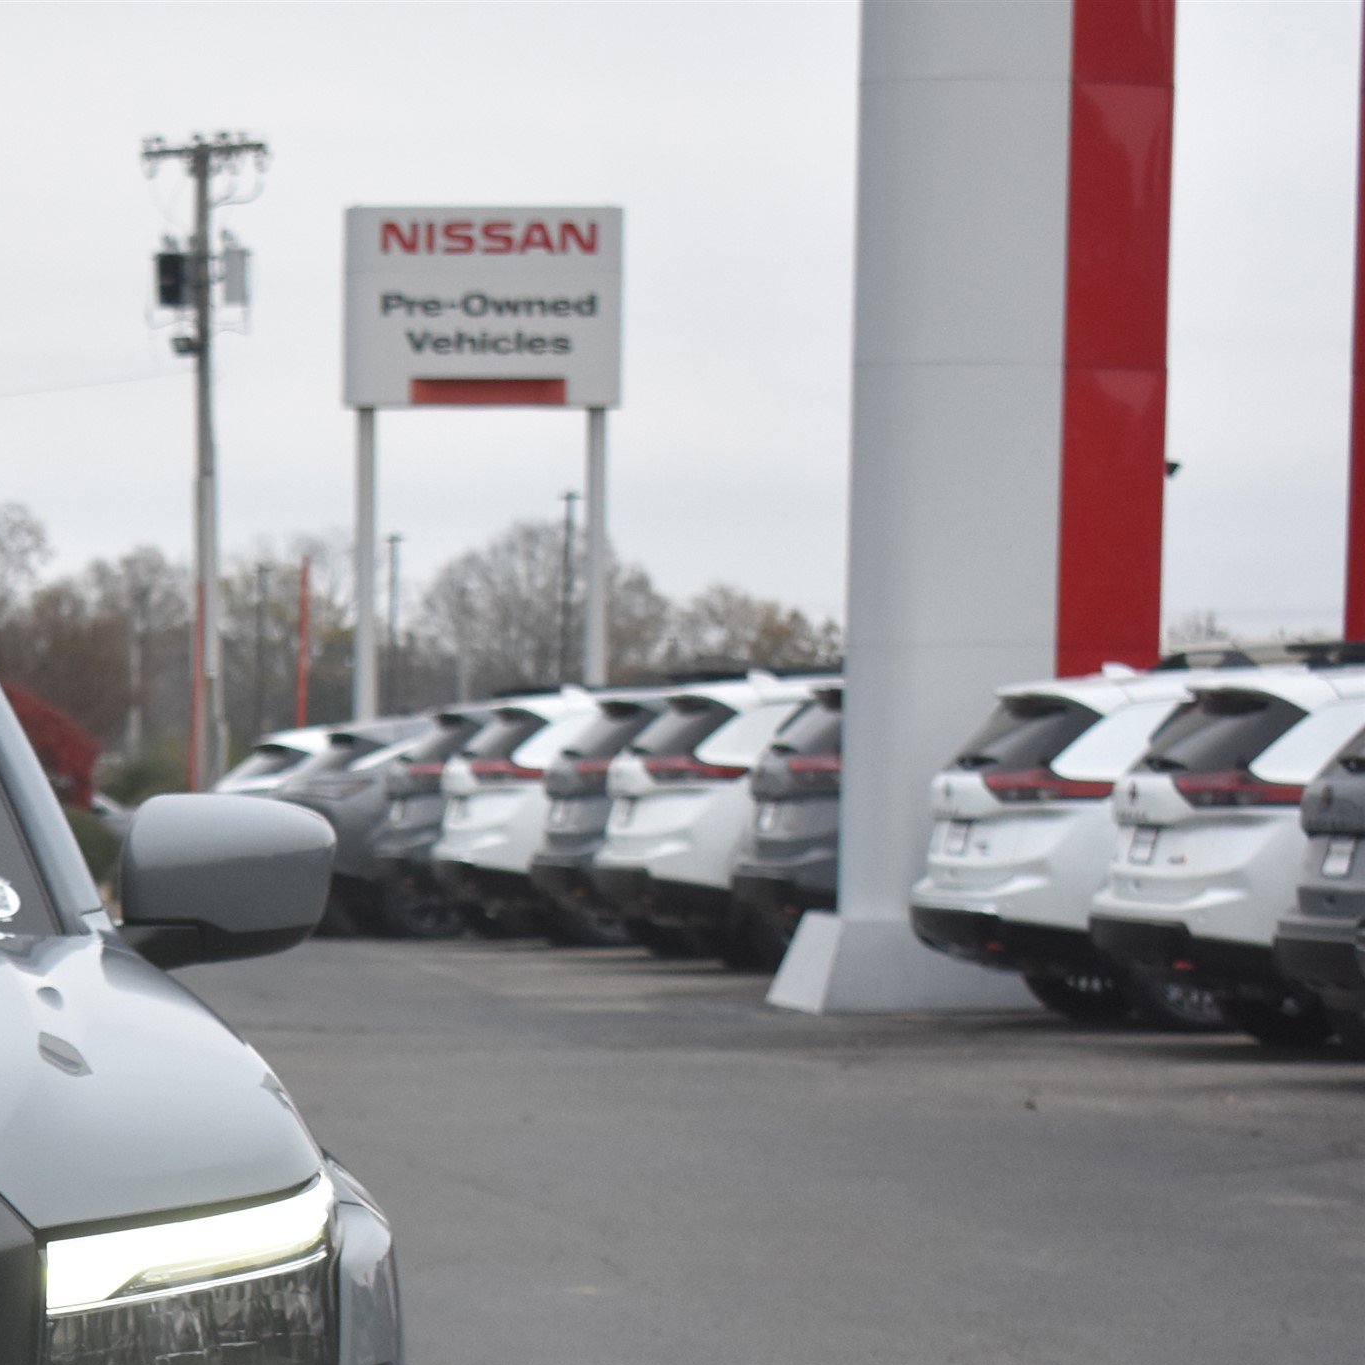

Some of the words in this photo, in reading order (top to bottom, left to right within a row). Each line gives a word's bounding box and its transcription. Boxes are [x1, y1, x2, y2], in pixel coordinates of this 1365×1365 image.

[380, 220, 598, 256] NISSAN
[380, 292, 597, 317] Pre-Owned
[406, 330, 572, 355] Vehicles
